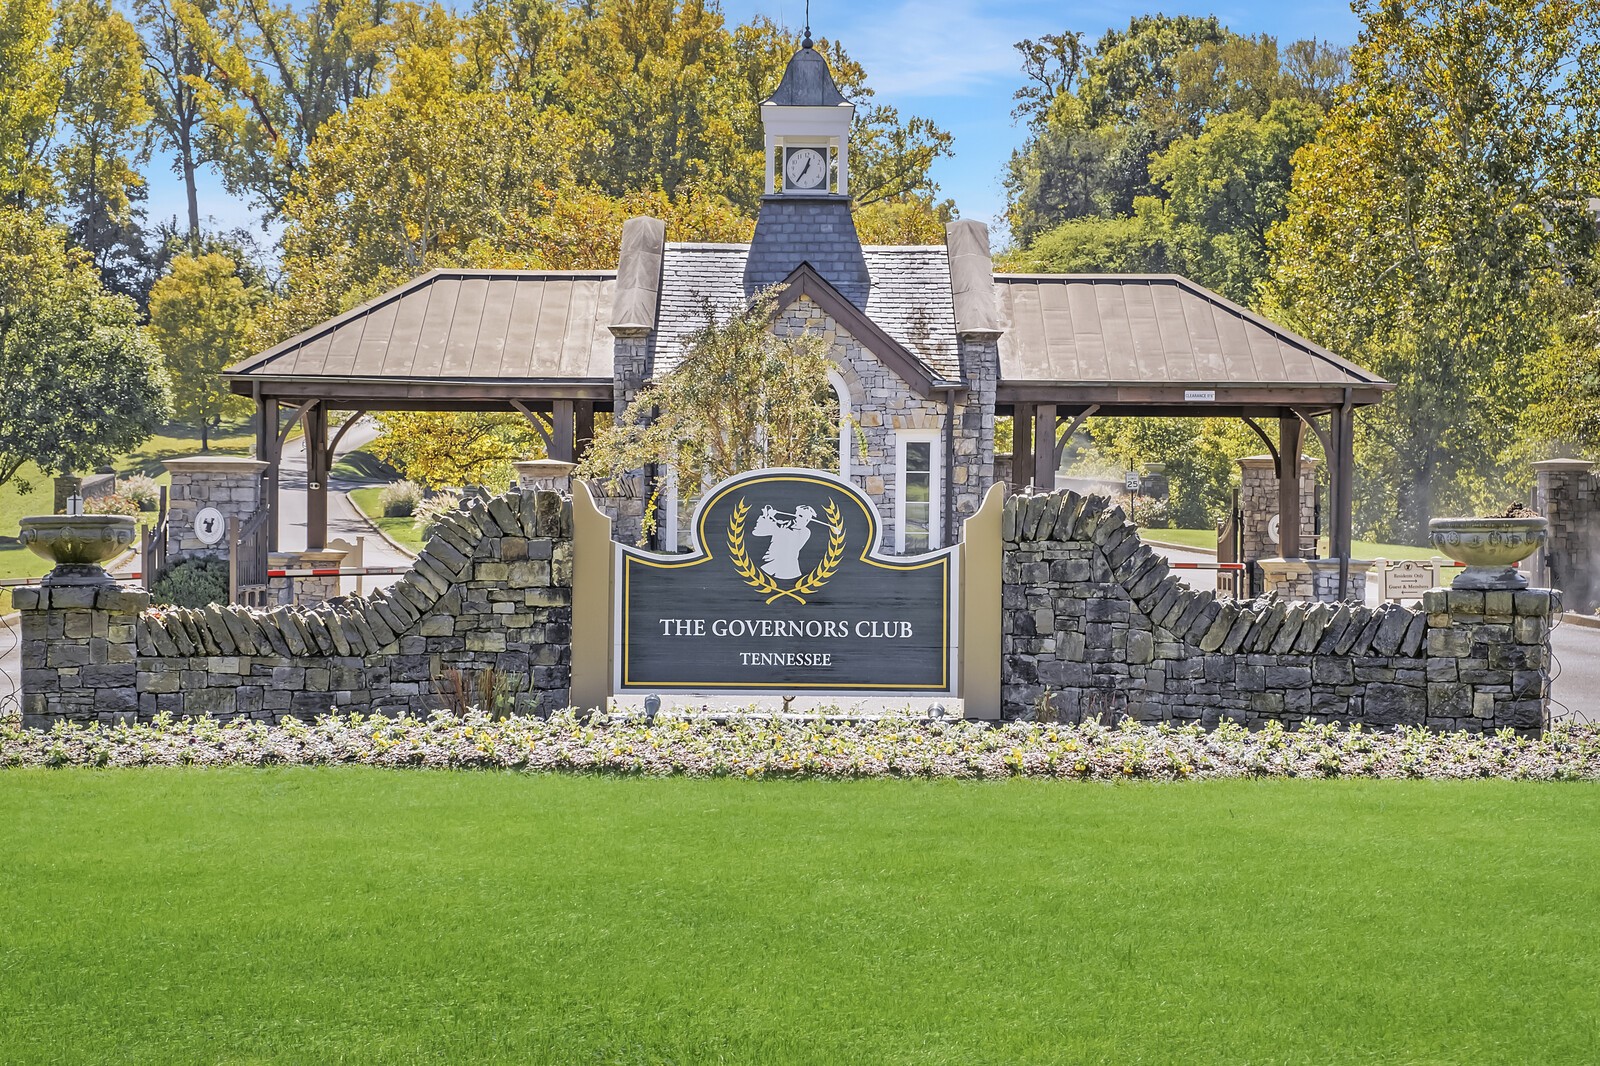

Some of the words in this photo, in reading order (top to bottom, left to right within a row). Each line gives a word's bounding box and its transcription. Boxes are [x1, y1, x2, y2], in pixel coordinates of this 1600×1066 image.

[659, 618, 707, 636] THE
[711, 619, 849, 638] GOVERNORS
[855, 620, 913, 638] CLUB
[739, 652, 832, 666] TENNESSEE
